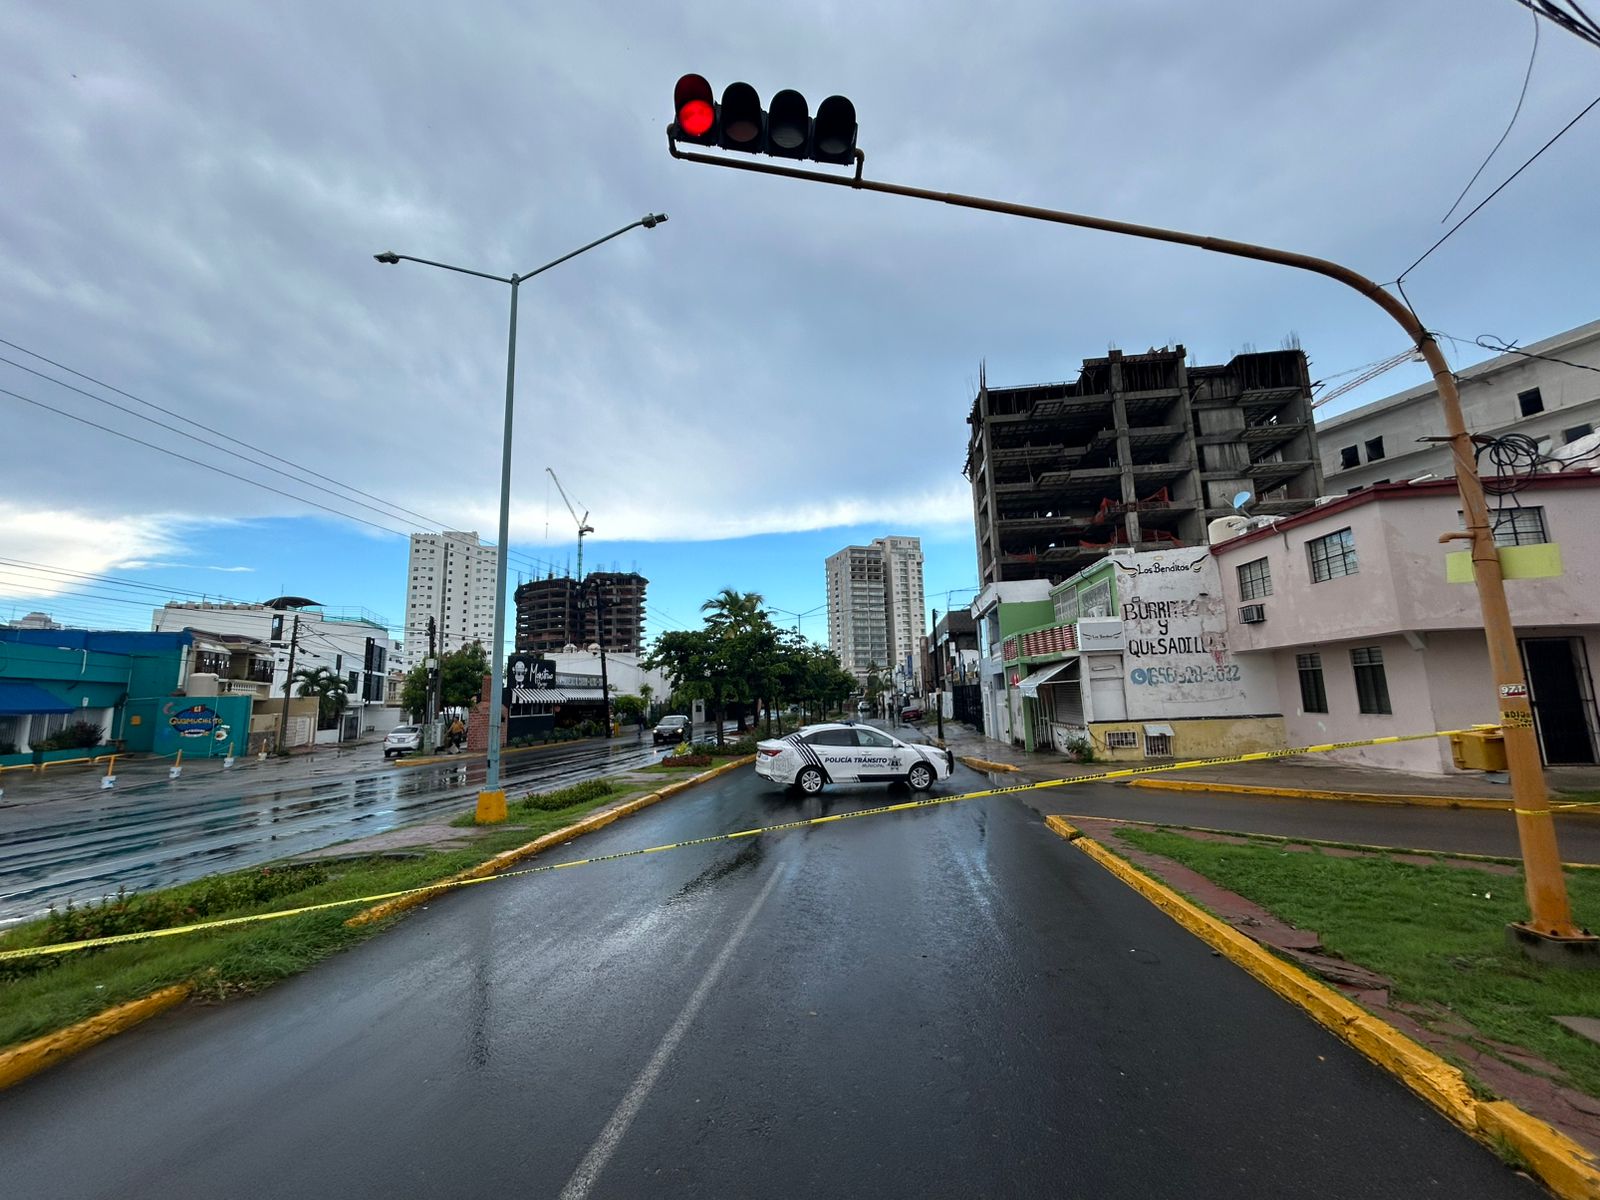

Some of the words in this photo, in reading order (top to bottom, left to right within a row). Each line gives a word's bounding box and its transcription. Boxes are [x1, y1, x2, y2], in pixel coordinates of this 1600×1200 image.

[1137, 564, 1153, 575] Los
[1153, 562, 1190, 574] Benditos
[1501, 685, 1522, 694] 97.1
